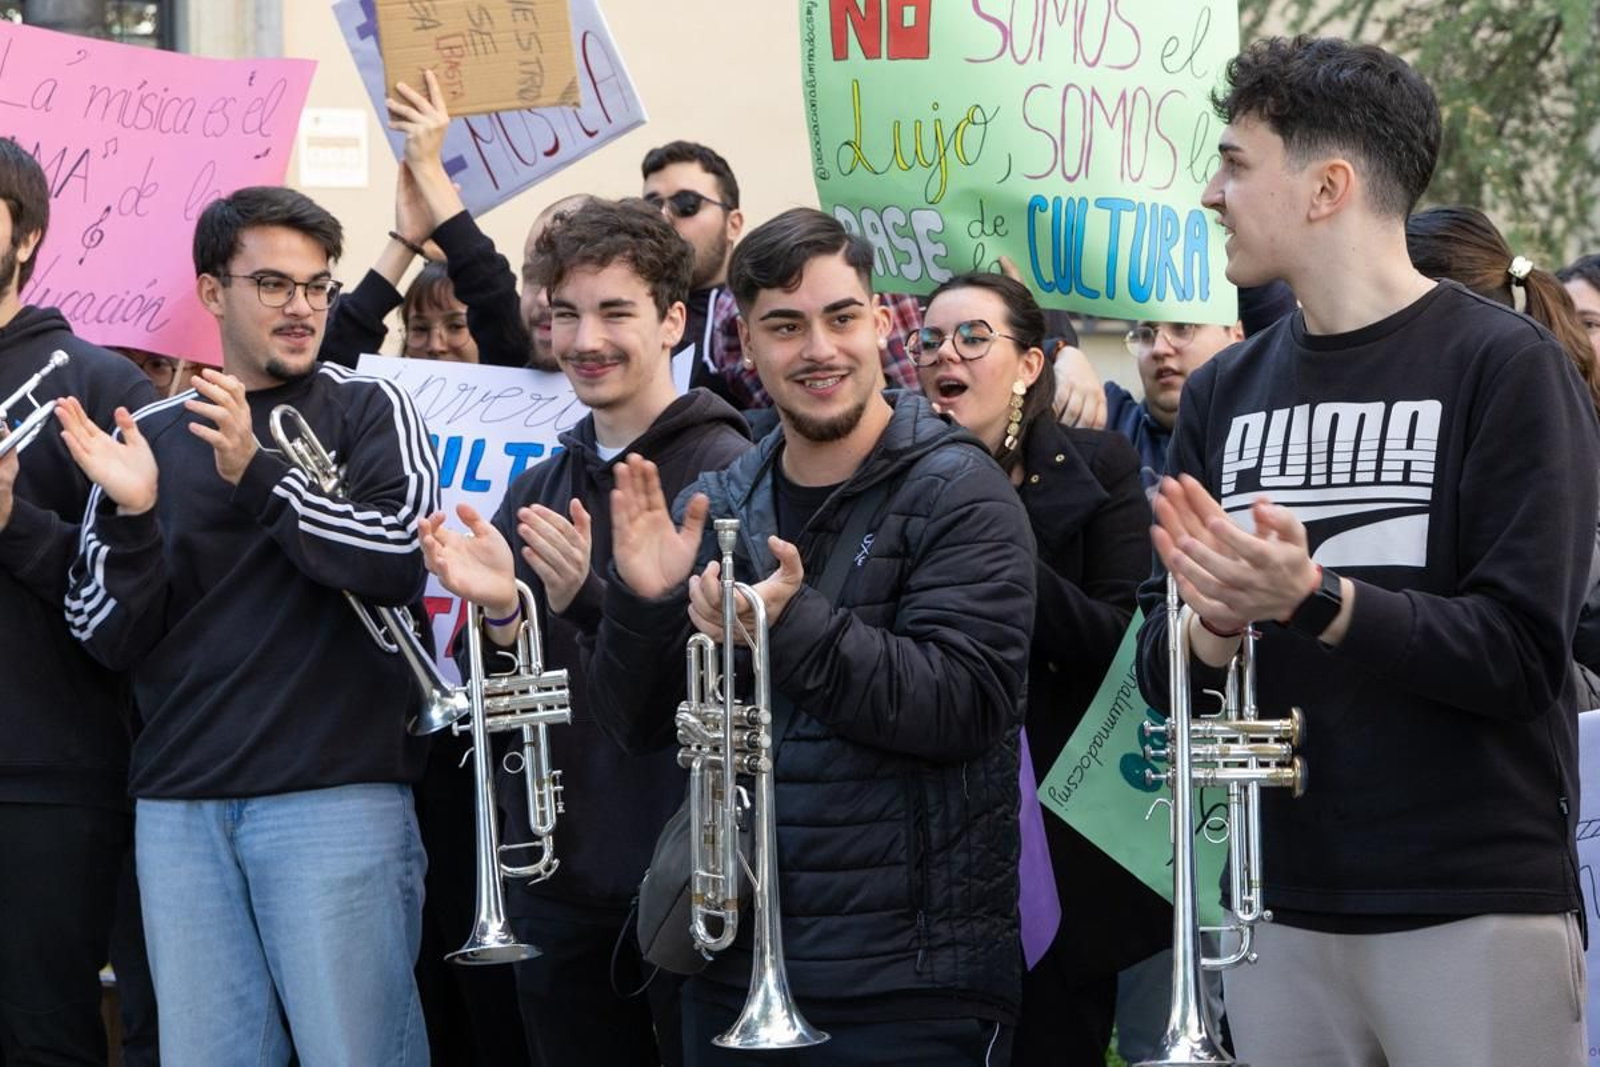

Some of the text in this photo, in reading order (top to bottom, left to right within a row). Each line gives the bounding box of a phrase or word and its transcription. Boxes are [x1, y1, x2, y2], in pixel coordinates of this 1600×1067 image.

[467, 5, 499, 57] SE
[508, 0, 545, 104] ESTRO
[830, 0, 1211, 79] NO SOMOS el
[0, 38, 58, 113] La
[84, 79, 197, 135] música
[202, 96, 239, 138] es
[1023, 83, 1187, 191] SOMOS
[31, 140, 90, 203] MA
[118, 157, 158, 218] de
[967, 198, 1009, 239] de
[1027, 194, 1210, 303] CULTURA
[1221, 399, 1442, 495] PUMA
